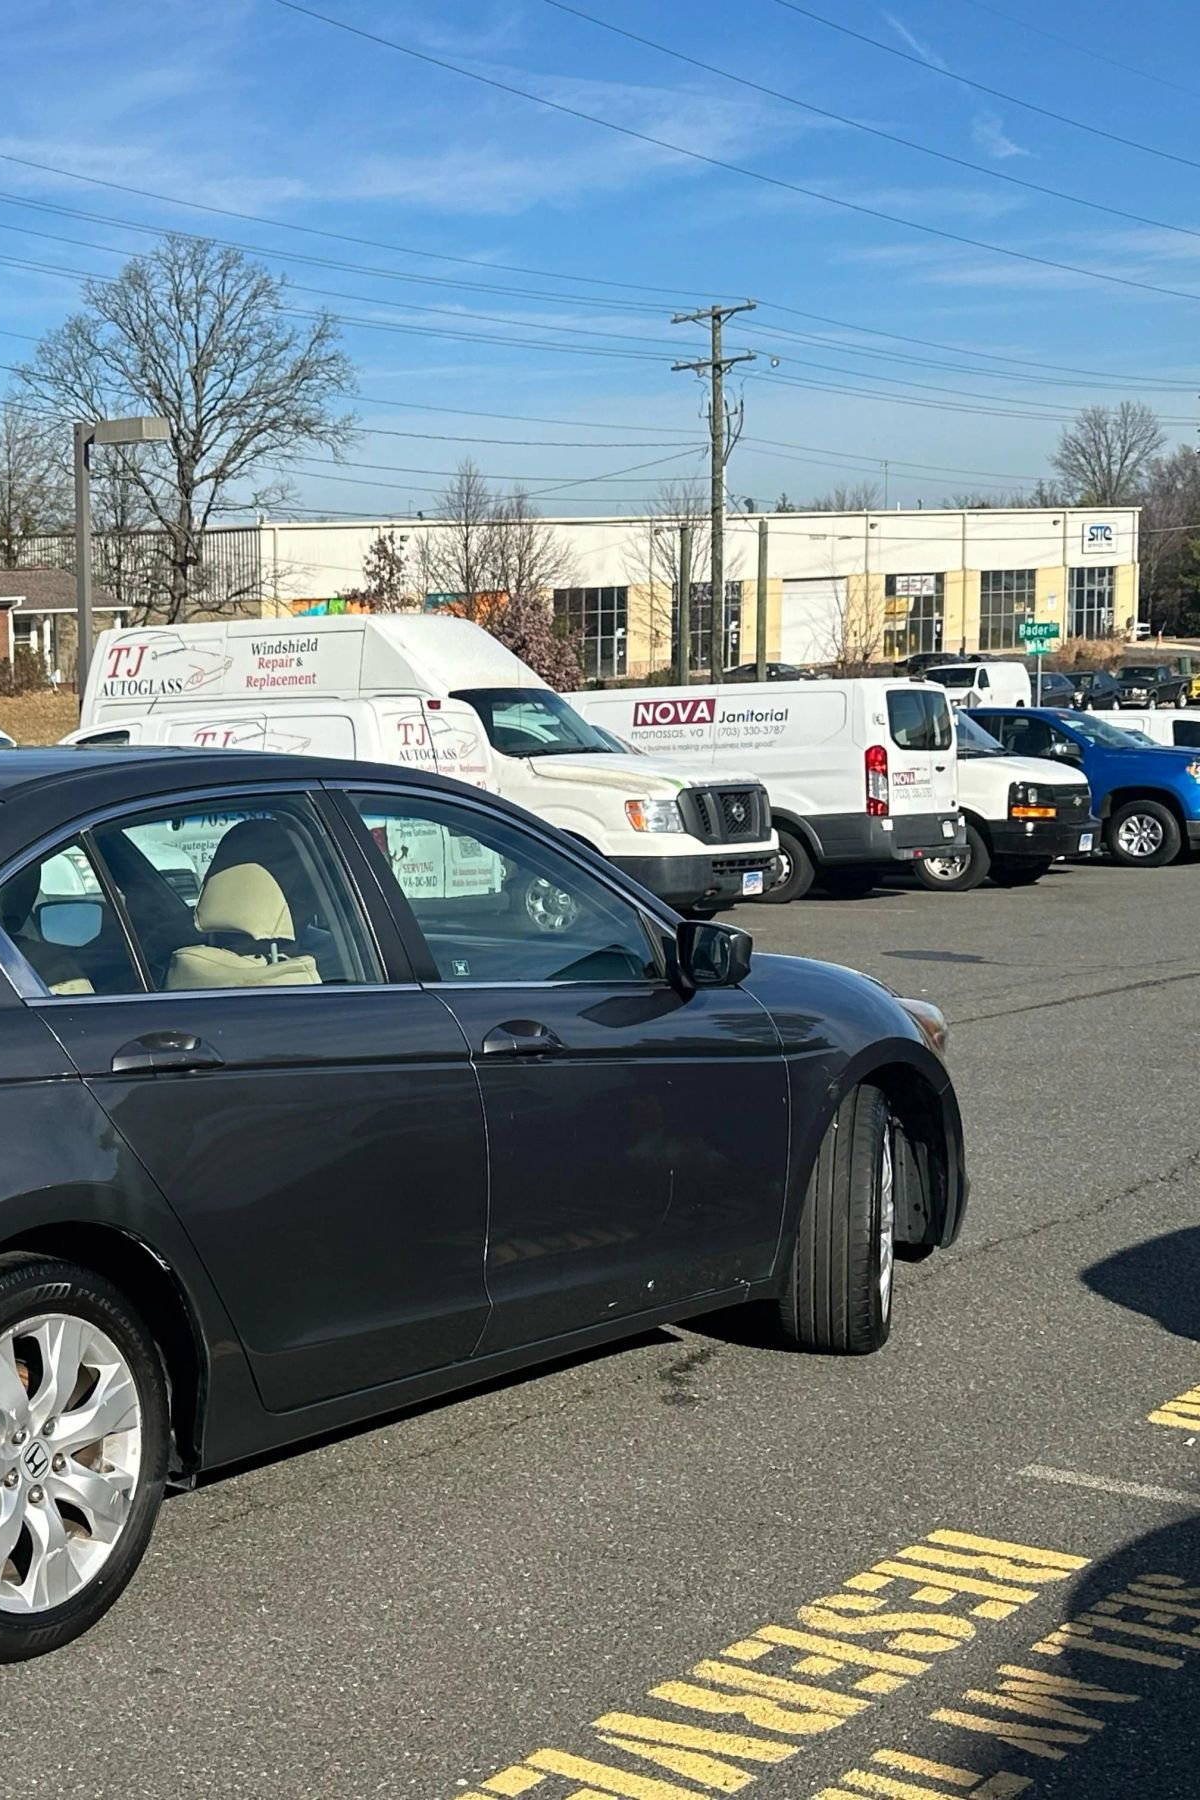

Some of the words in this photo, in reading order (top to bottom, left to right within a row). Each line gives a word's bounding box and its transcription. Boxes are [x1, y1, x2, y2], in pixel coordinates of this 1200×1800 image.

[1019, 623, 1048, 638] Bader
[251, 638, 318, 656] Windshield
[107, 645, 149, 679] TJ
[257, 657, 295, 672] Repair
[296, 658, 303, 667] &
[100, 677, 183, 697] AUTOGLASS
[246, 673, 317, 690] Replacement
[636, 700, 711, 725] NOVA
[718, 708, 789, 724] Janitorial
[397, 723, 427, 746] TJ
[743, 725, 786, 736] 330-3787
[399, 747, 458, 761] AUTOGLASS
[893, 772, 915, 786] NOVA
[450, 1529, 1092, 1800] RESERVE
